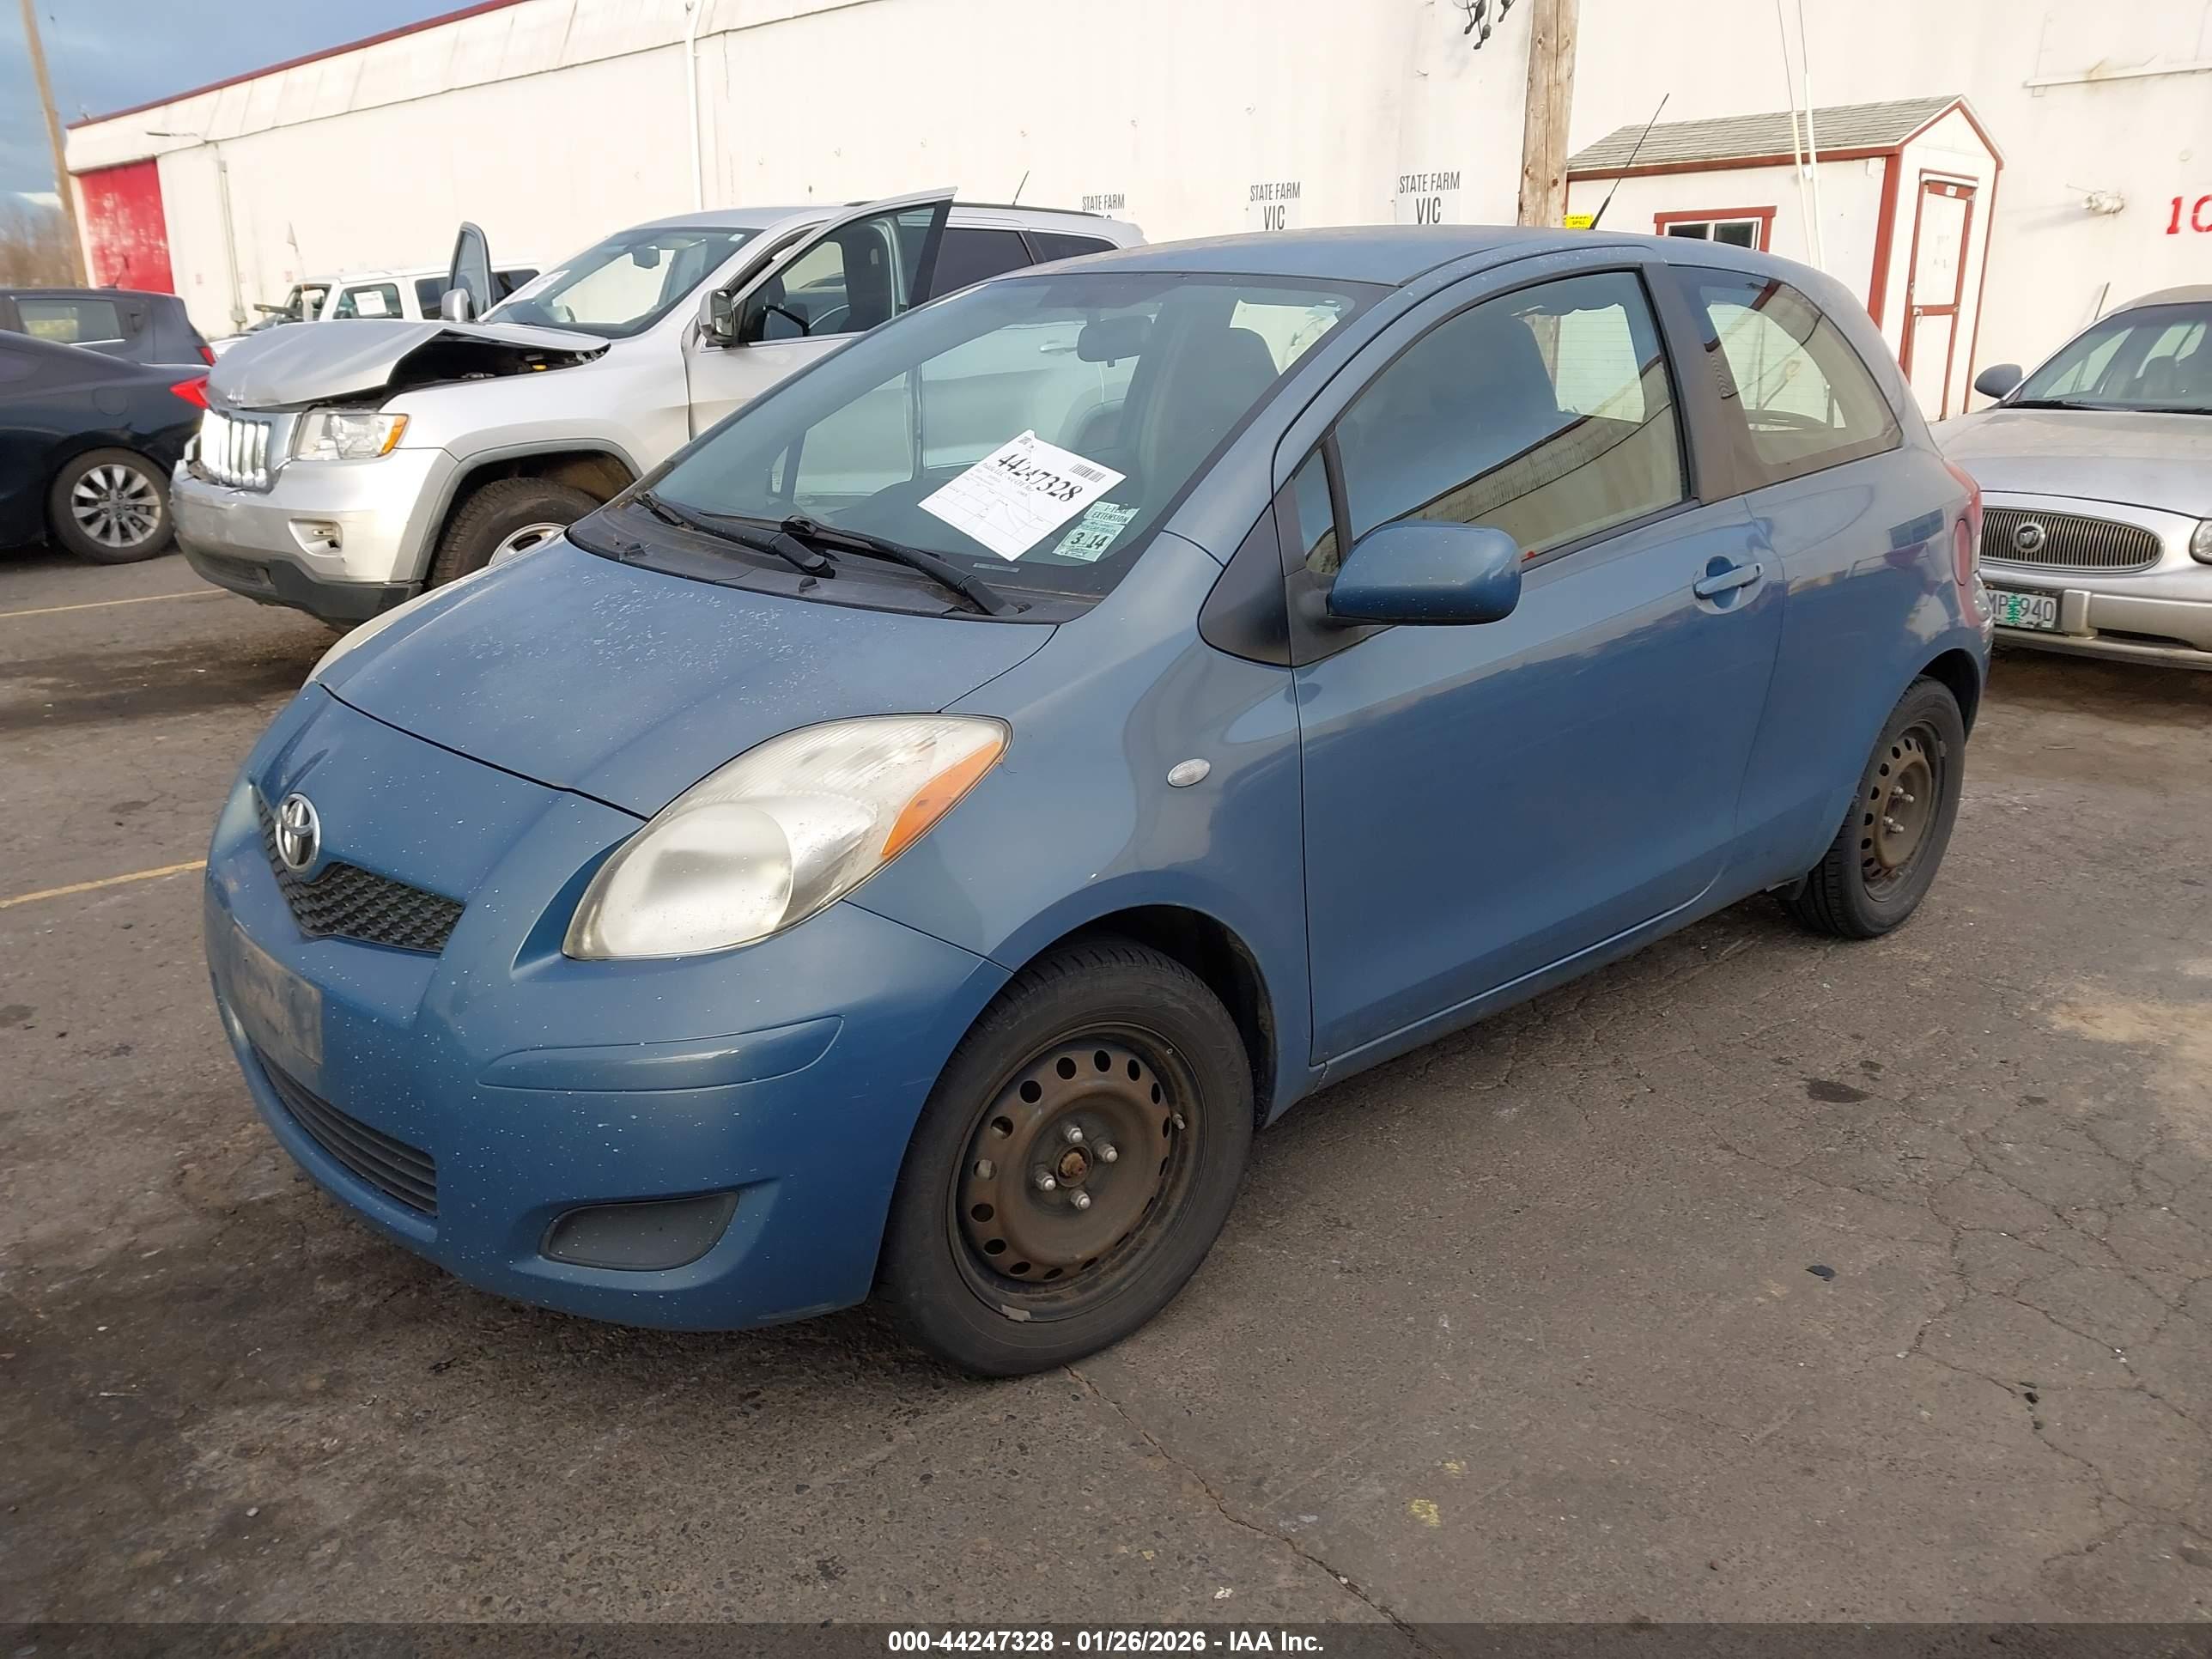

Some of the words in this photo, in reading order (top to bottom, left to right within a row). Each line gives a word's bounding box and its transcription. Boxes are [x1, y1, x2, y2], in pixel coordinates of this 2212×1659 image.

[1250, 184, 1273, 202] STATE
[1276, 181, 1300, 200] FARM
[1400, 174, 1428, 194] STATE
[1431, 171, 1460, 191] FARM
[1083, 195, 1102, 211] STATE
[1104, 193, 1125, 210] FARM
[1416, 197, 1442, 225] VIC
[1264, 204, 1285, 231] VIC
[997, 453, 1083, 501] 44247328
[1091, 511, 1130, 523] EXTENSION
[1071, 532, 1085, 544] 3
[1086, 534, 1109, 550] 14
[2020, 598, 2054, 621] 940
